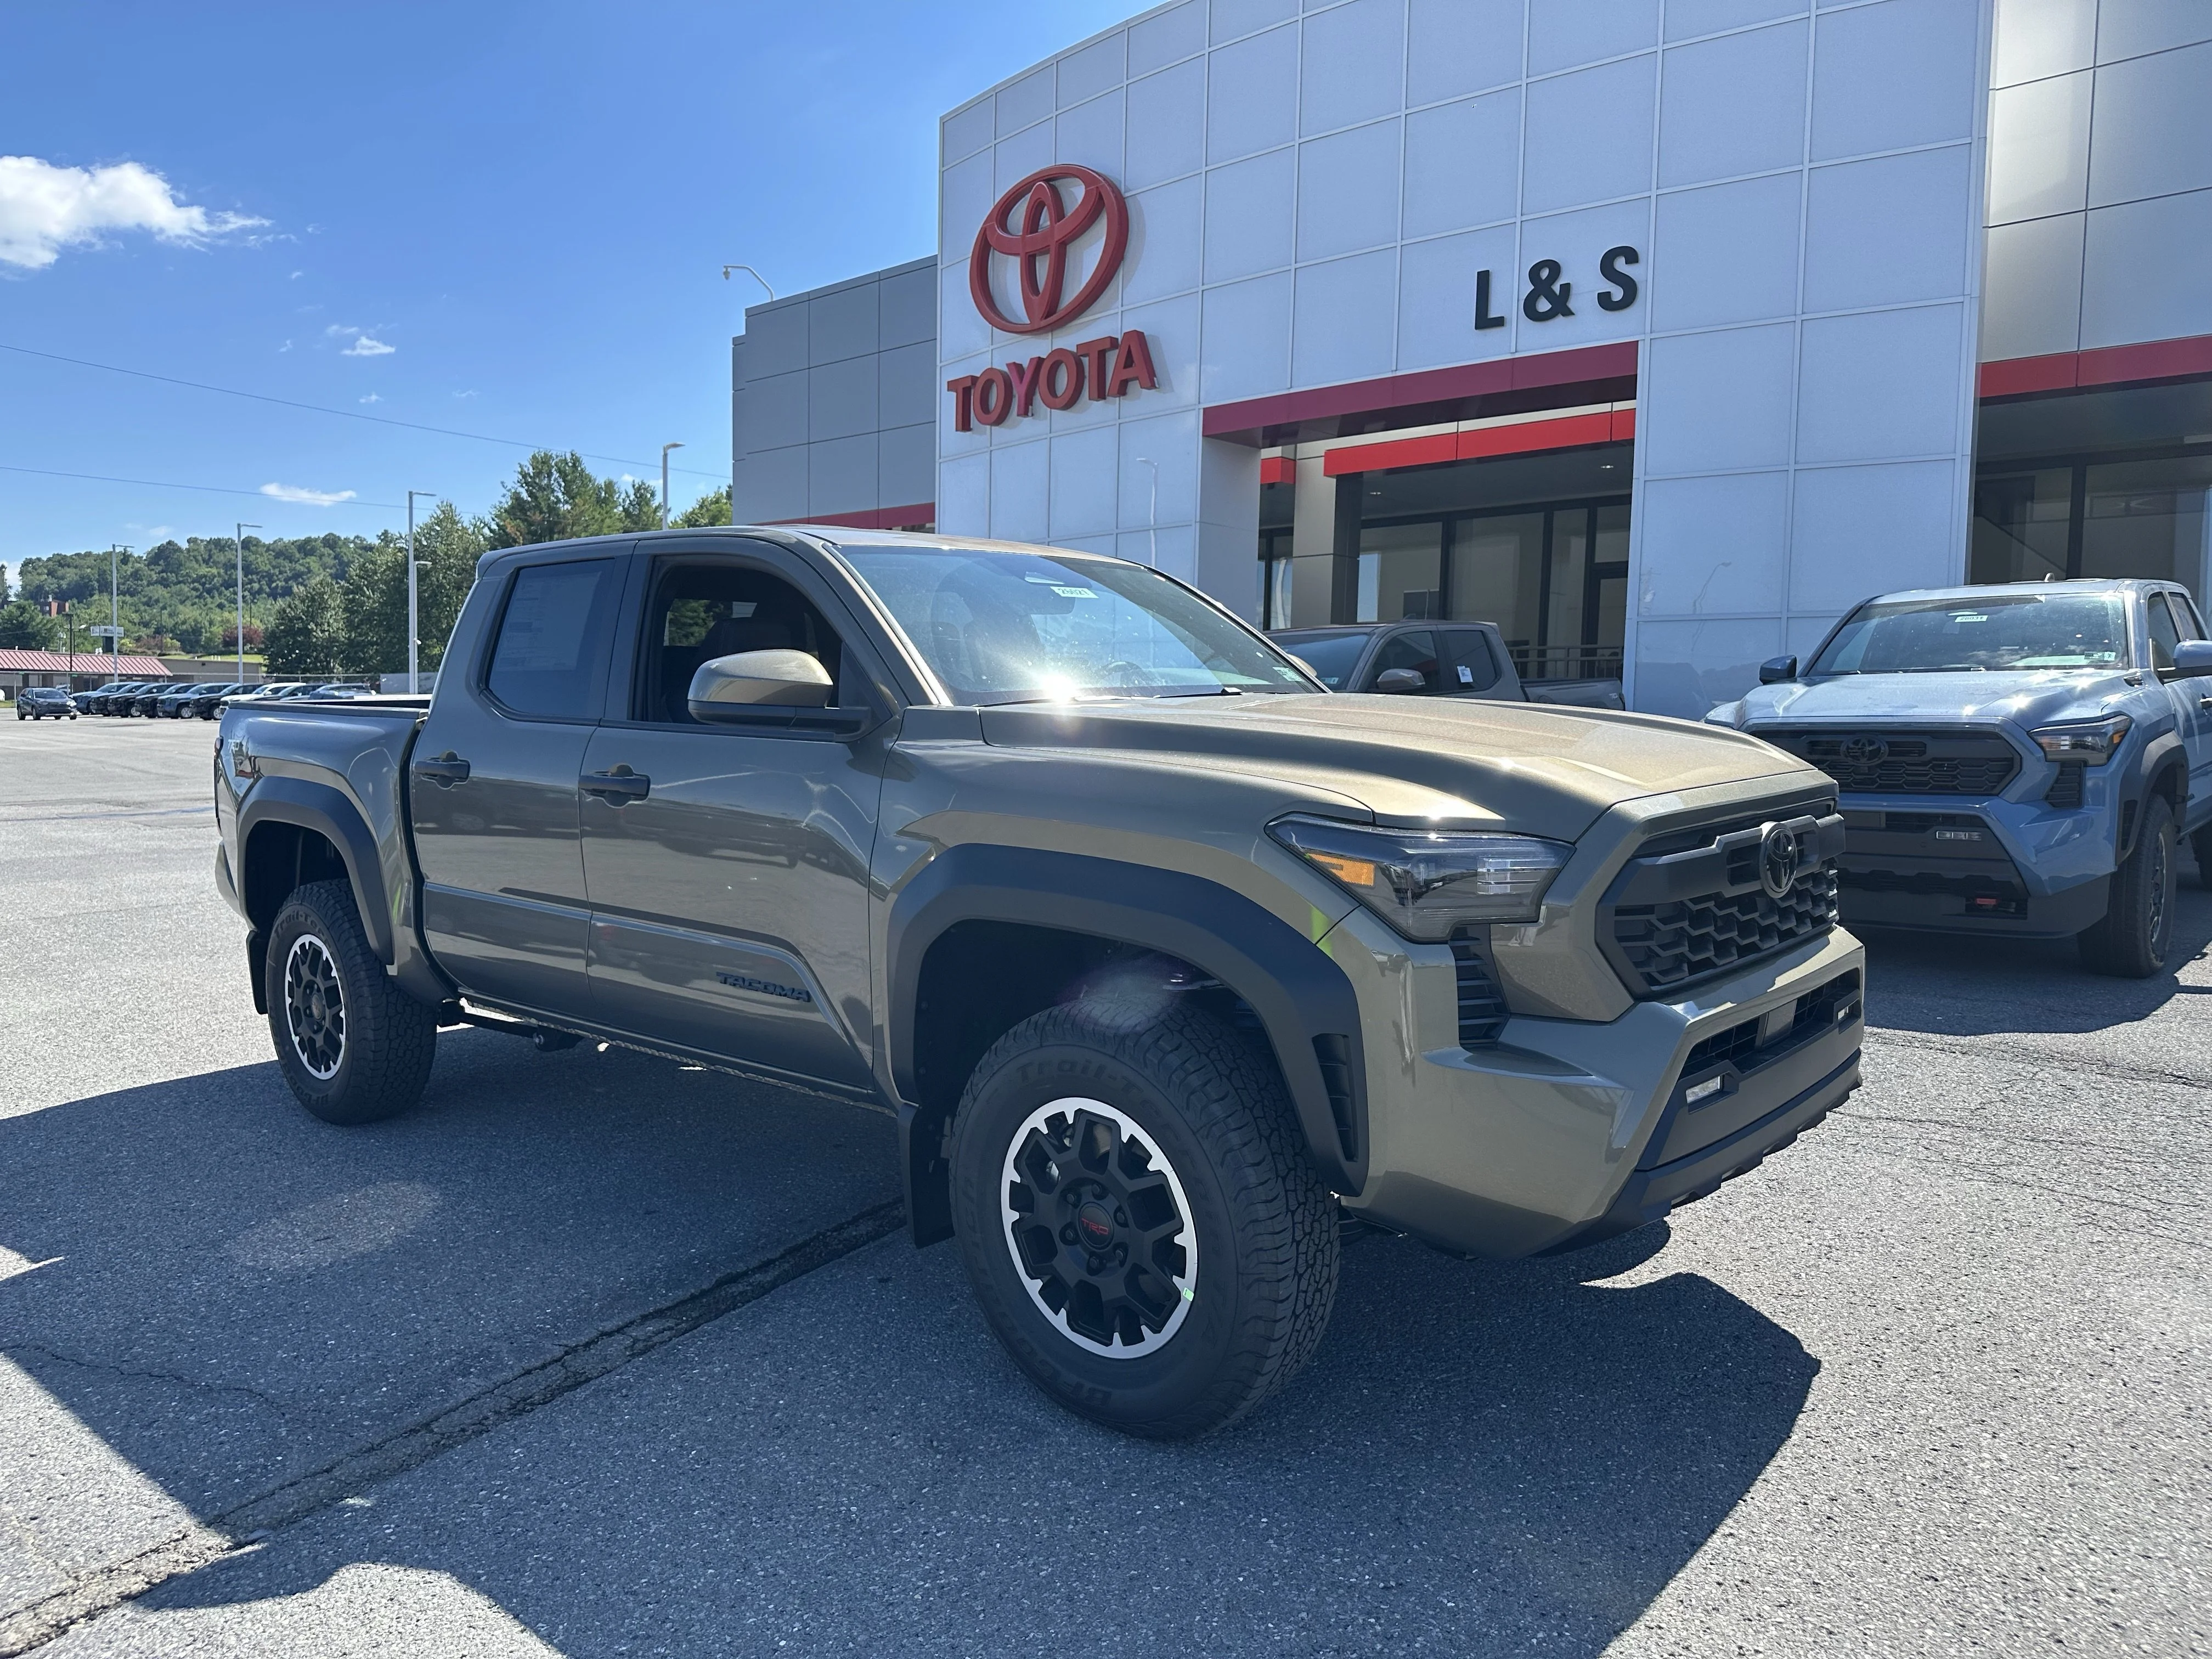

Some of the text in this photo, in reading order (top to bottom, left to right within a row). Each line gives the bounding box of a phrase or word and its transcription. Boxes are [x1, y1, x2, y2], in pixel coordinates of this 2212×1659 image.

[1475, 246, 1639, 330] L & S
[947, 330, 1159, 432] TOYOTA
[716, 972, 811, 1002] TACOMA
[1081, 1217, 1109, 1235] TRD
